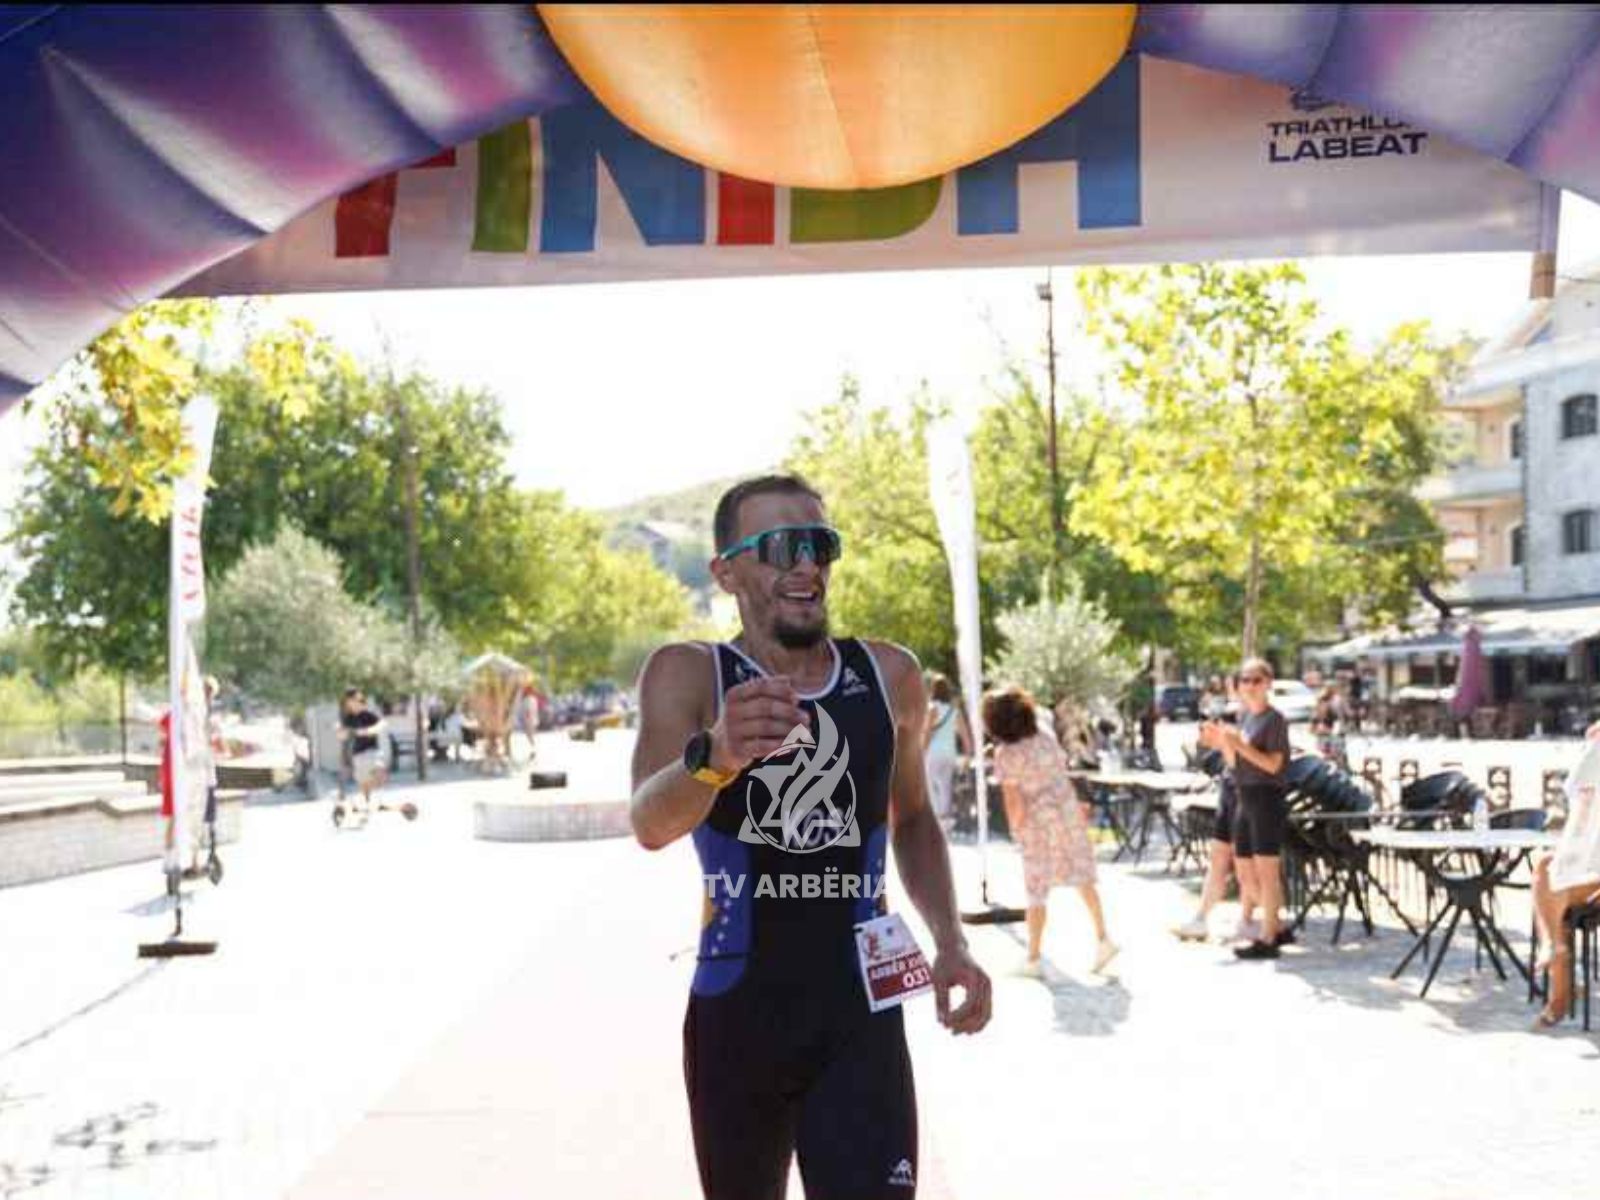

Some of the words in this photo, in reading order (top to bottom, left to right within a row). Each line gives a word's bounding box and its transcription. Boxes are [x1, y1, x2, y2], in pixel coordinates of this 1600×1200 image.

[1267, 115, 1413, 138] TRIATHLO
[335, 54, 1142, 258] INH
[1268, 133, 1428, 163] LABEAT
